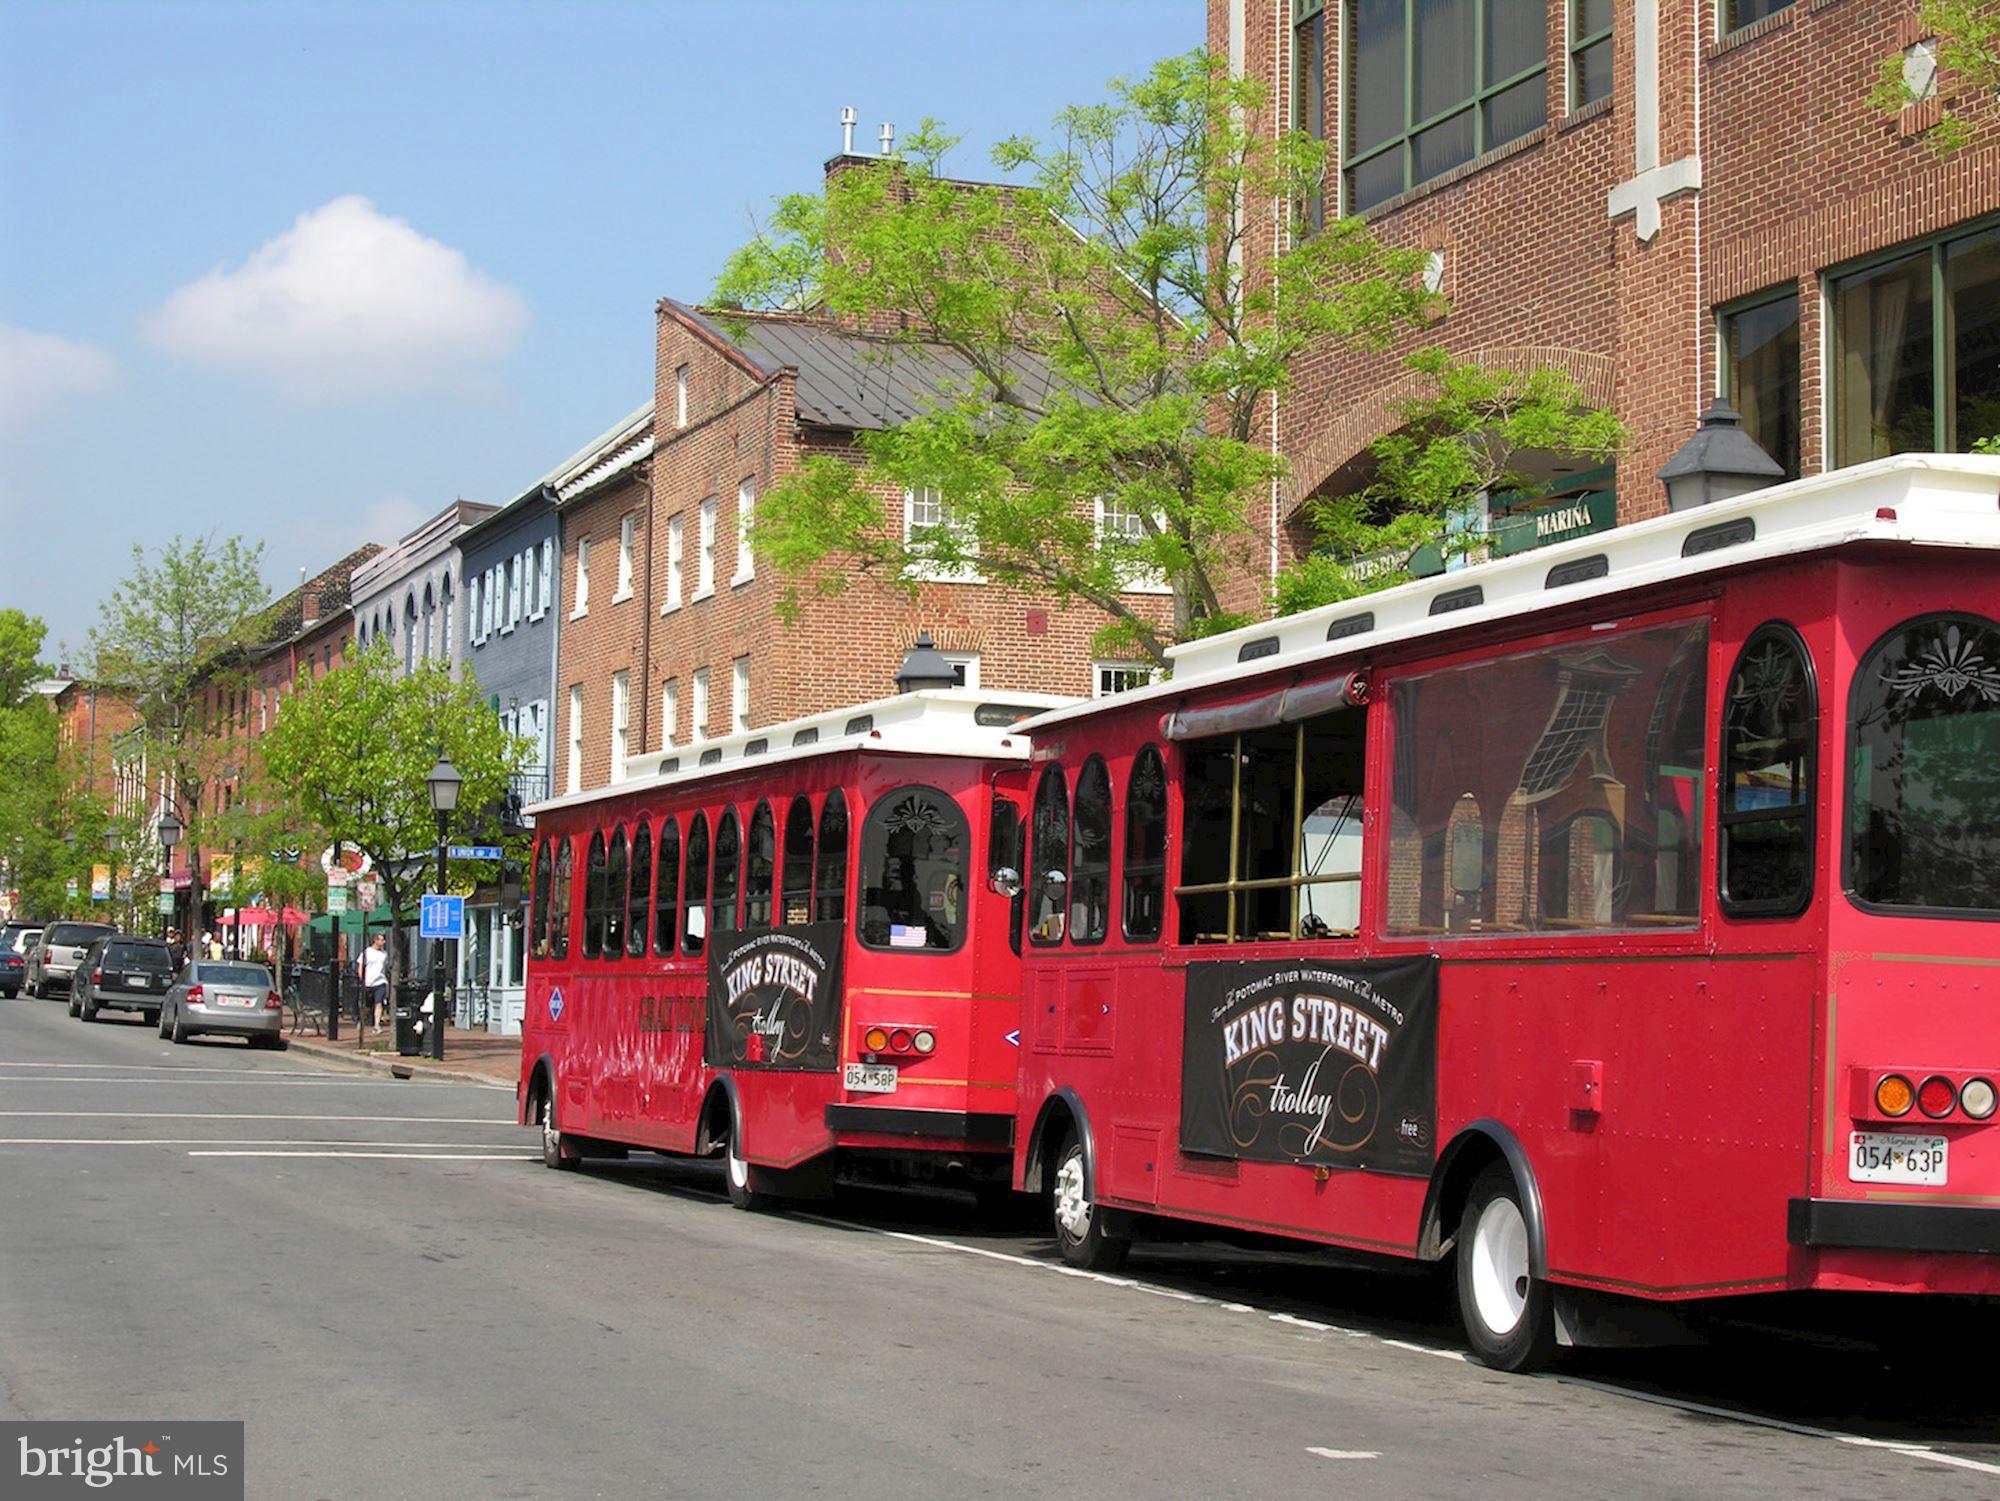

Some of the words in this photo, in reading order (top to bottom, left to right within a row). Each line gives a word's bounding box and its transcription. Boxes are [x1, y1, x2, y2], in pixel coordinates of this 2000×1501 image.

[1536, 504, 1592, 537] MARINA
[726, 956, 763, 1006] KING
[764, 953, 818, 1003] STREET
[1234, 975, 1273, 1003] POTOMAC
[1274, 970, 1300, 985] RIVER
[1299, 969, 1355, 990] WATERFRONT
[1371, 992, 1405, 1026] METRO
[752, 985, 787, 1064] trolley
[1223, 999, 1286, 1065] KING
[1291, 995, 1389, 1070] STREET
[846, 1070, 868, 1085] 054
[873, 1072, 895, 1087] 58P
[1269, 1045, 1333, 1156] trolley
[1400, 1117, 1419, 1137] free
[1856, 1146, 1893, 1170] 054
[1906, 1149, 1943, 1173] 63P
